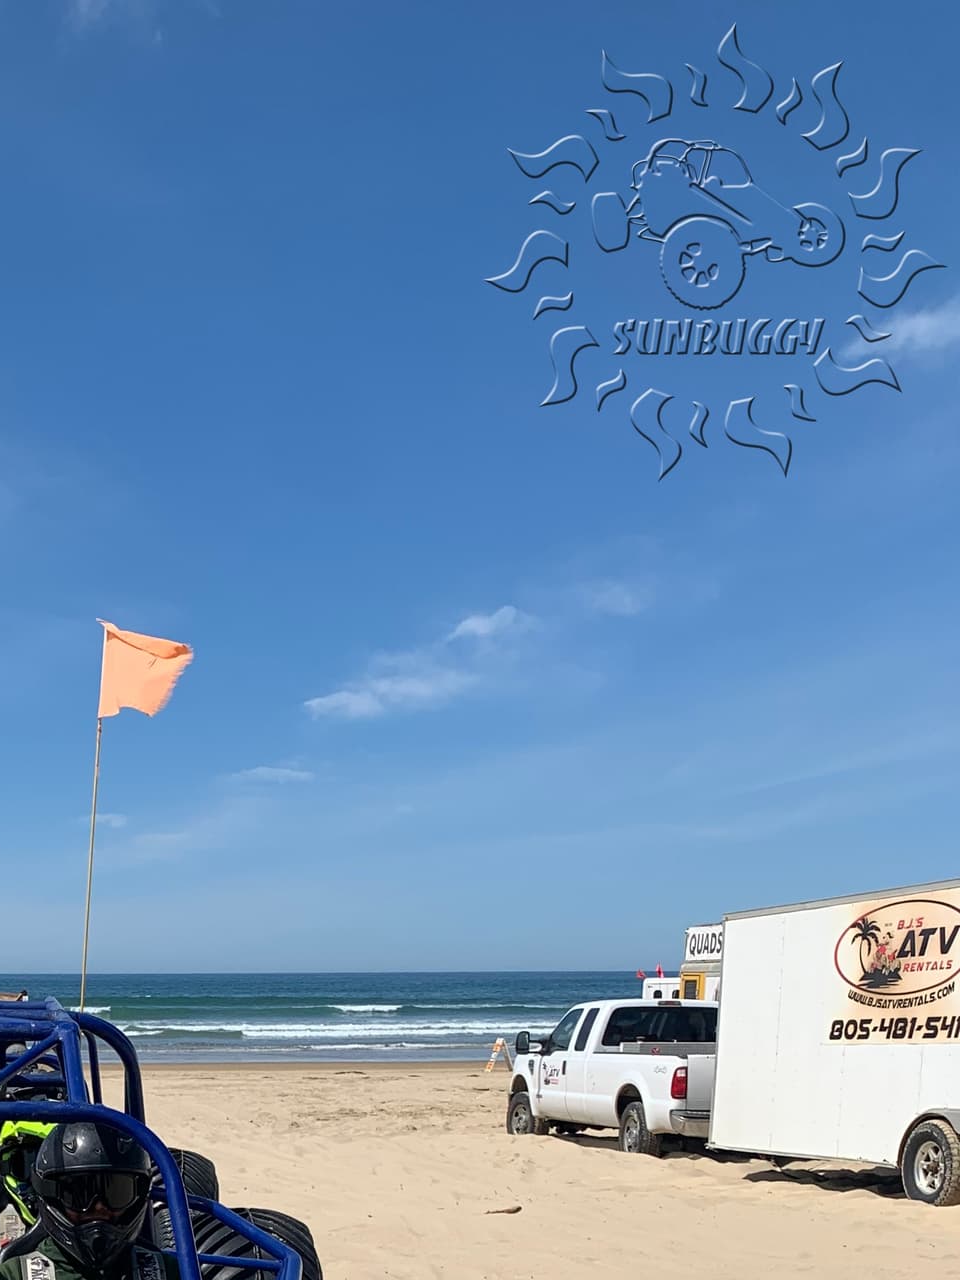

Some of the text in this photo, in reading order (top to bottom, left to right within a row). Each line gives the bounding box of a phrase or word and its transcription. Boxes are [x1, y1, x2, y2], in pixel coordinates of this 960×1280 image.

[689, 931, 723, 957] QUADS
[896, 925, 960, 958] ATV
[902, 959, 953, 972] RENTALS
